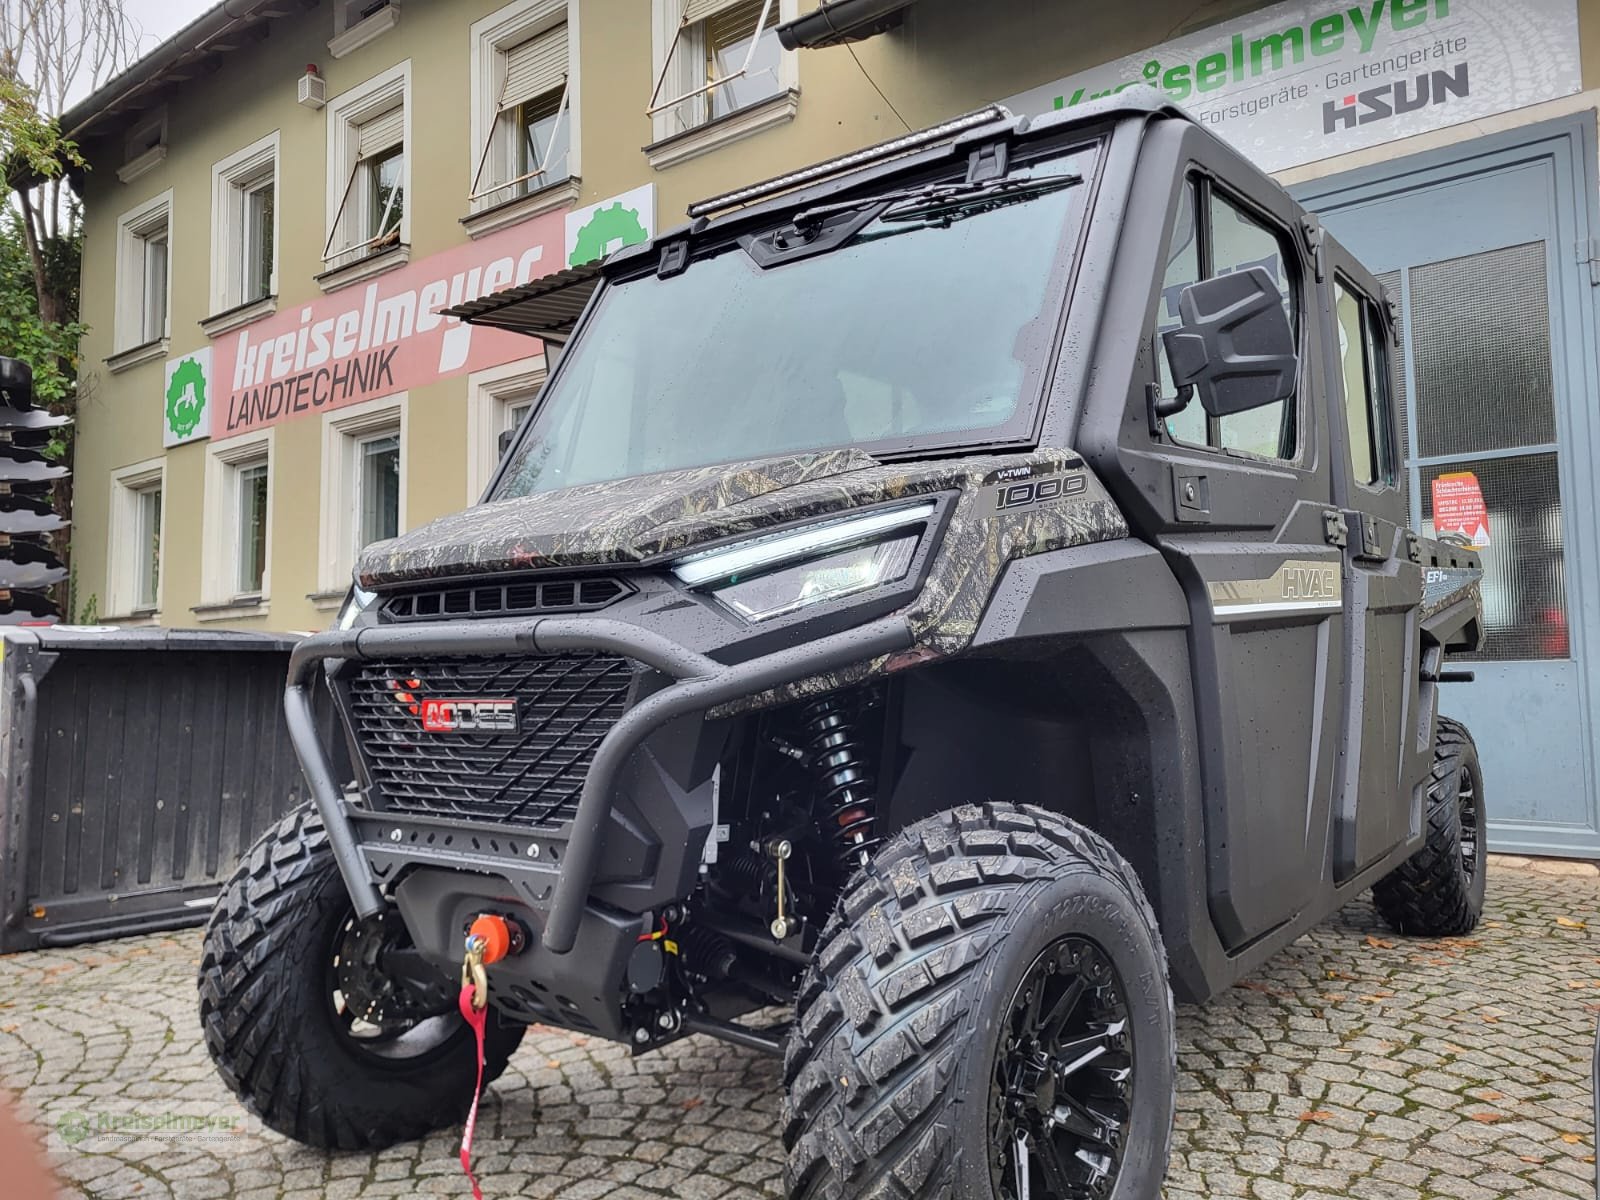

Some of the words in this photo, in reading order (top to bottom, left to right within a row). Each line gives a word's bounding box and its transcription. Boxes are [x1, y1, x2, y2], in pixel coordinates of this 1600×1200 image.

[1054, 0, 1449, 110] selmeye
[1200, 85, 1308, 124] Forstgeräte
[1326, 36, 1467, 90] Gartengeräte
[232, 245, 544, 392] kreiselmeyer
[227, 345, 398, 431] LANDTECHNIK
[996, 473, 1088, 510] 1000
[997, 466, 1031, 479] V-TWIN
[1281, 567, 1334, 598] HVAC
